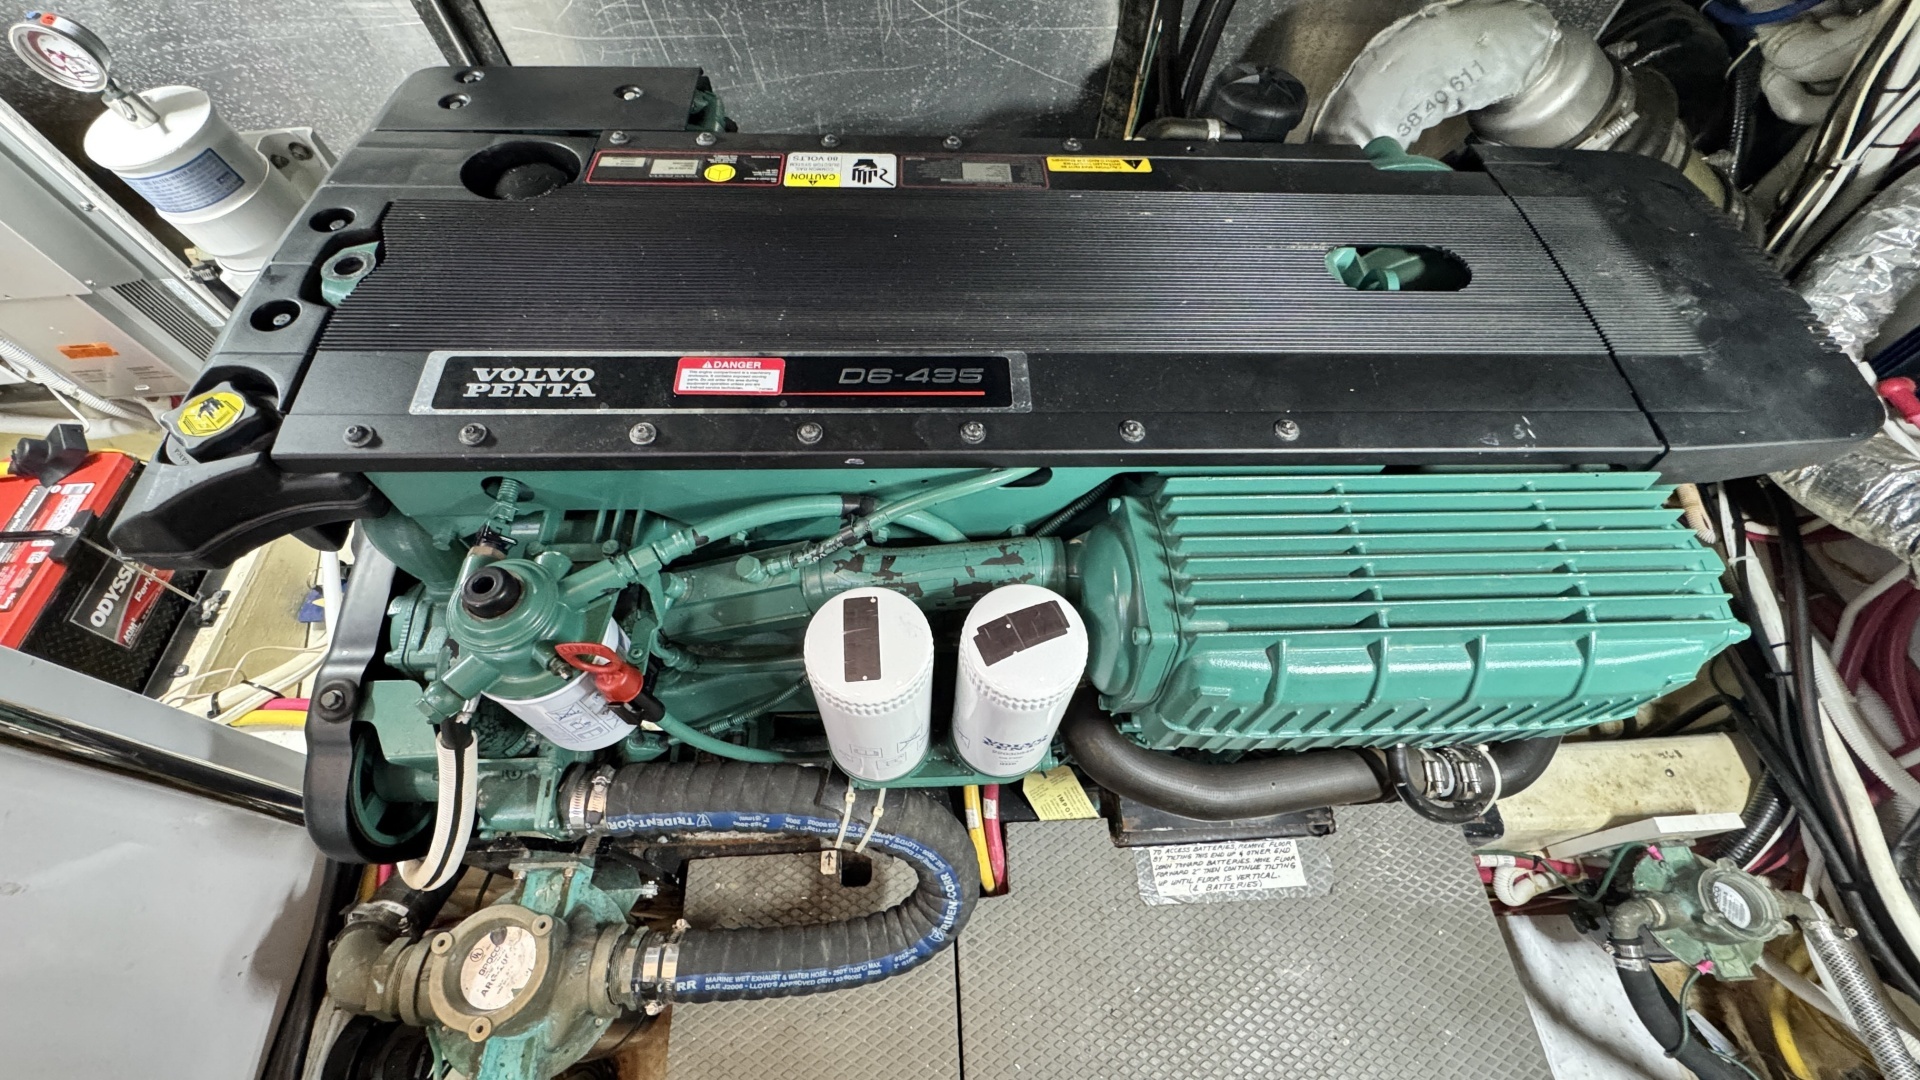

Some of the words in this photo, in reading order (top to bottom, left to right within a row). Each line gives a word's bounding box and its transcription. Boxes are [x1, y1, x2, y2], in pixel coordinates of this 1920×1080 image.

[472, 367, 596, 382] VOLVO
[838, 368, 984, 384] D6-435
[462, 383, 596, 398] PENTA
[90, 561, 141, 628] ODYSSE
[1057, 794, 1074, 818] IMPOR
[606, 816, 695, 831] TRIDENT-COR
[1224, 864, 1261, 872] CONTINUE
[1171, 878, 1193, 886] UNTIL
[1236, 872, 1280, 880] VERTICAL.
[751, 974, 782, 982] EXHAUST
[789, 972, 809, 980] WATER
[810, 970, 827, 978] HOSE
[779, 980, 815, 988] APPROVED
